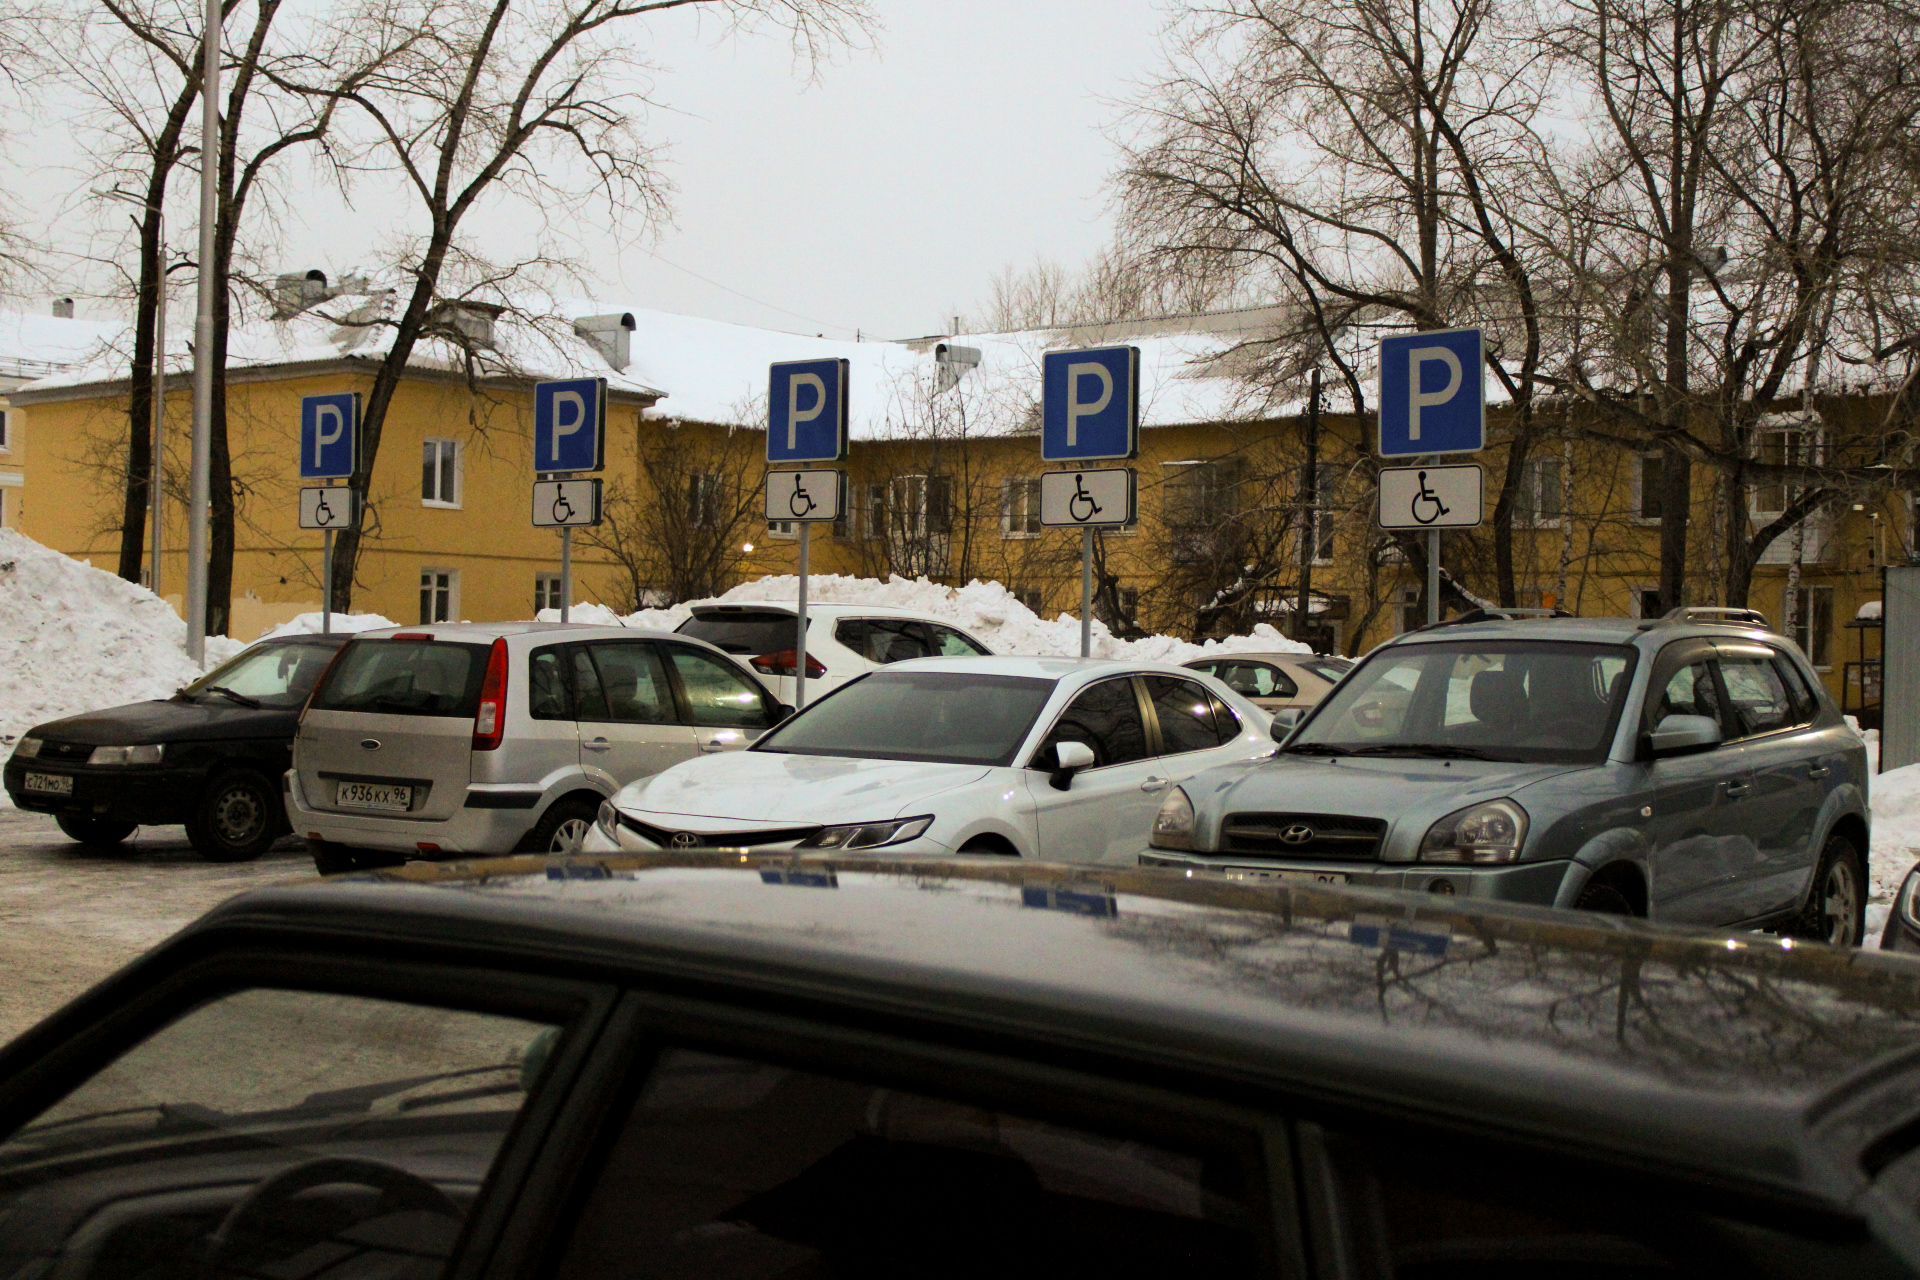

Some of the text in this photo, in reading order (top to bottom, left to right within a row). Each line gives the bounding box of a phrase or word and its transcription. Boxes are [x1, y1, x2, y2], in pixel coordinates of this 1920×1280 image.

[551, 390, 586, 461] P
[787, 372, 827, 450] P
[1066, 361, 1114, 447] P
[1409, 346, 1462, 440] P
[314, 403, 344, 468] P
